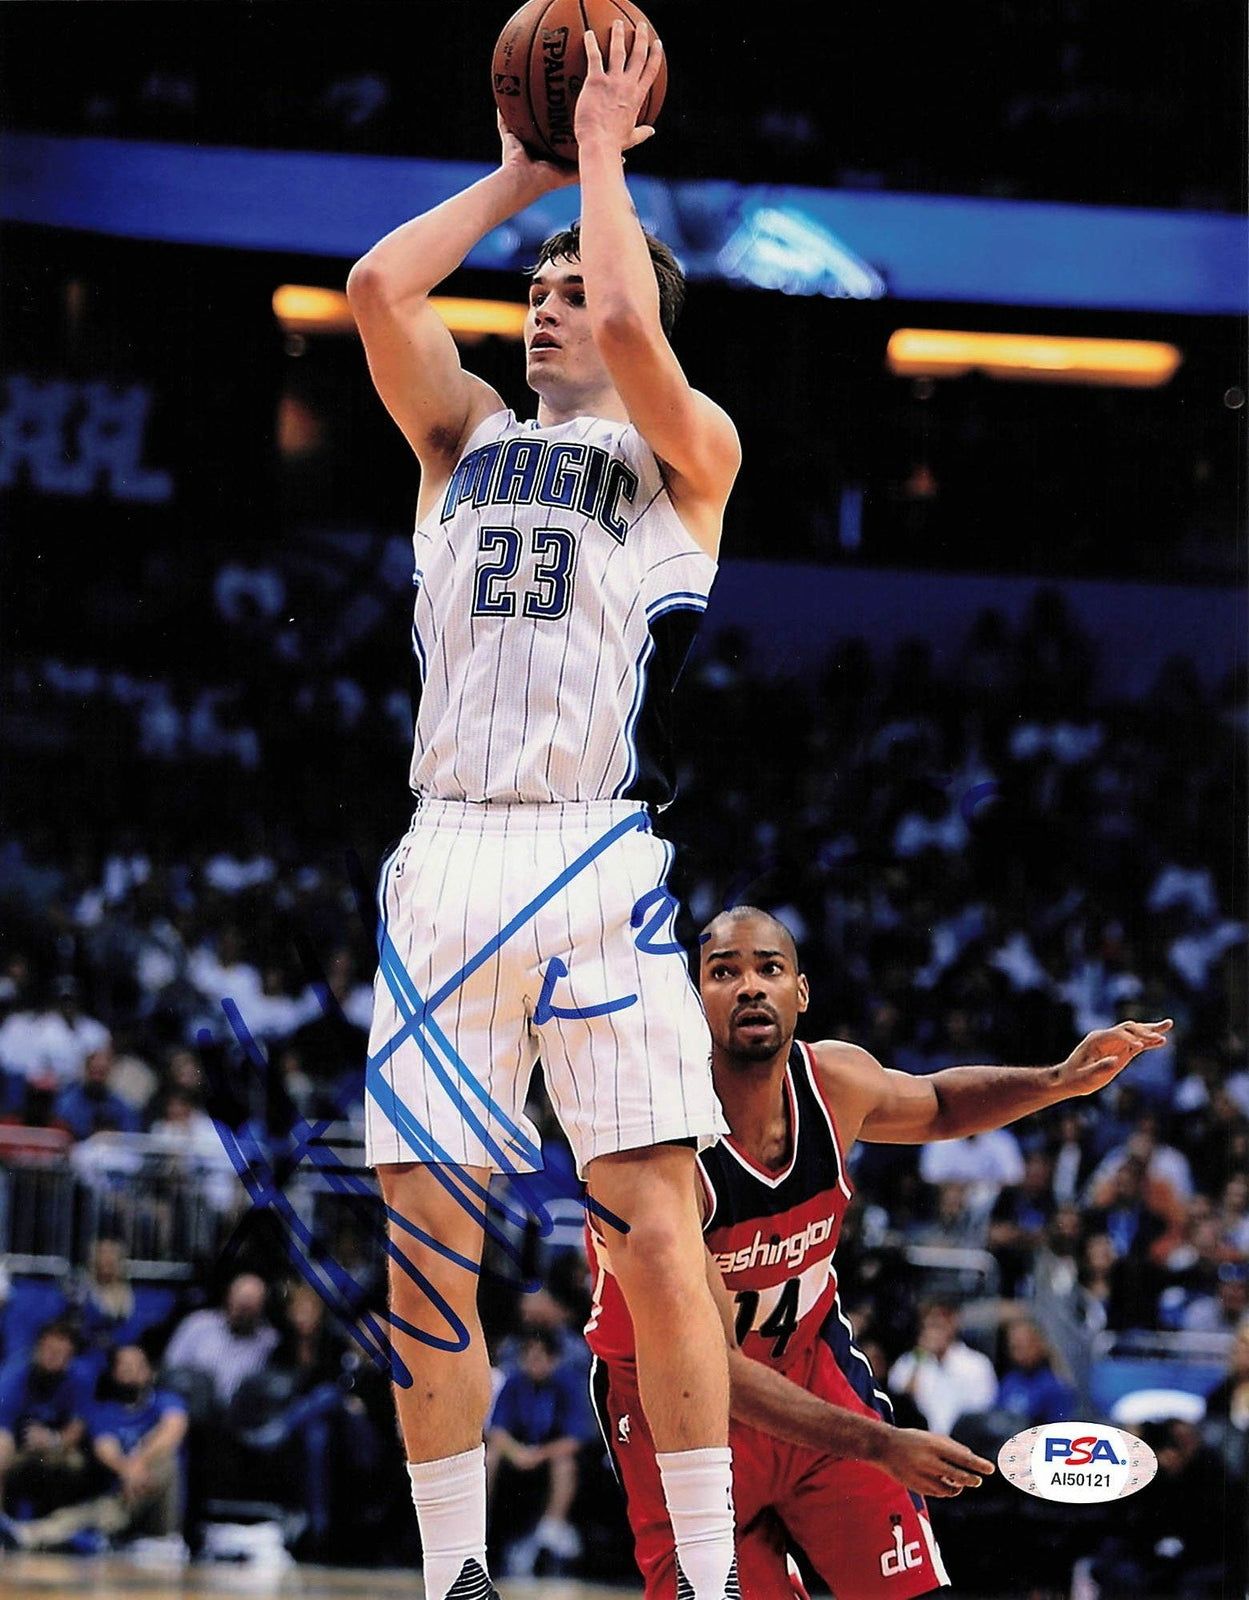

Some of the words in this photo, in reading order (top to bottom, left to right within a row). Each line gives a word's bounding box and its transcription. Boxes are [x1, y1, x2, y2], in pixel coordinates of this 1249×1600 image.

[440, 438, 639, 546] MAGIC
[471, 526, 576, 620] 23
[734, 1278, 801, 1358] 14
[1051, 1472, 1110, 1488] AI50121
[881, 1525, 923, 1577] dc
